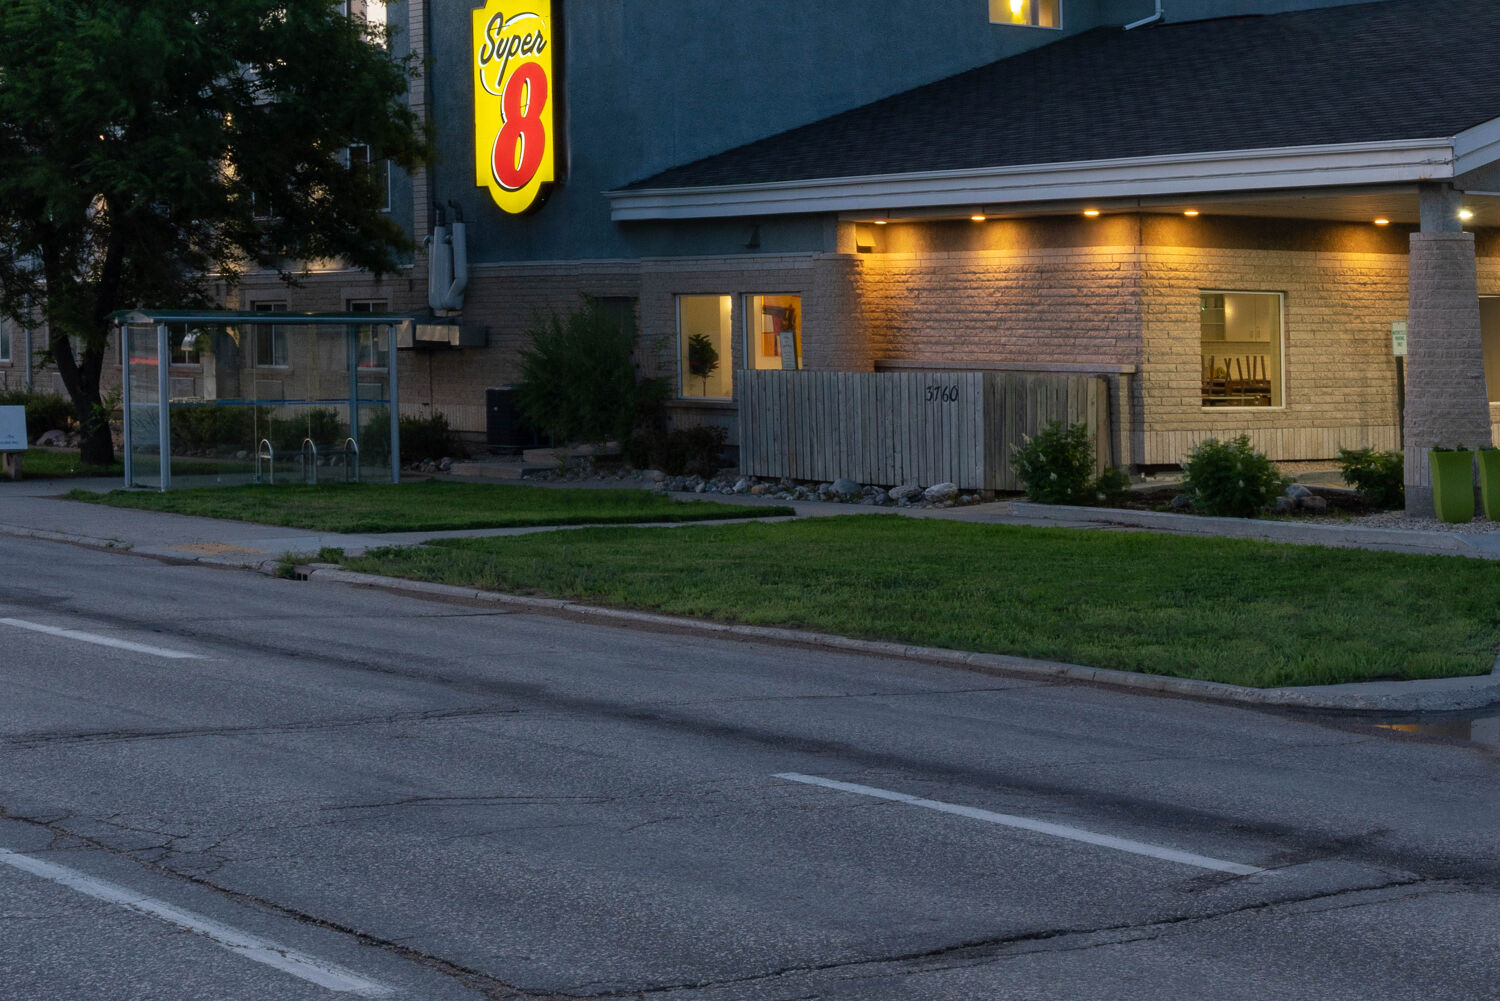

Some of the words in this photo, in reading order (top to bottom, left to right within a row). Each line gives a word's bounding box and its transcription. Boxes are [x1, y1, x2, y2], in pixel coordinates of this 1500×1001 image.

[478, 11, 547, 89] Super
[491, 61, 547, 192] 8
[925, 384, 959, 403] 3760
